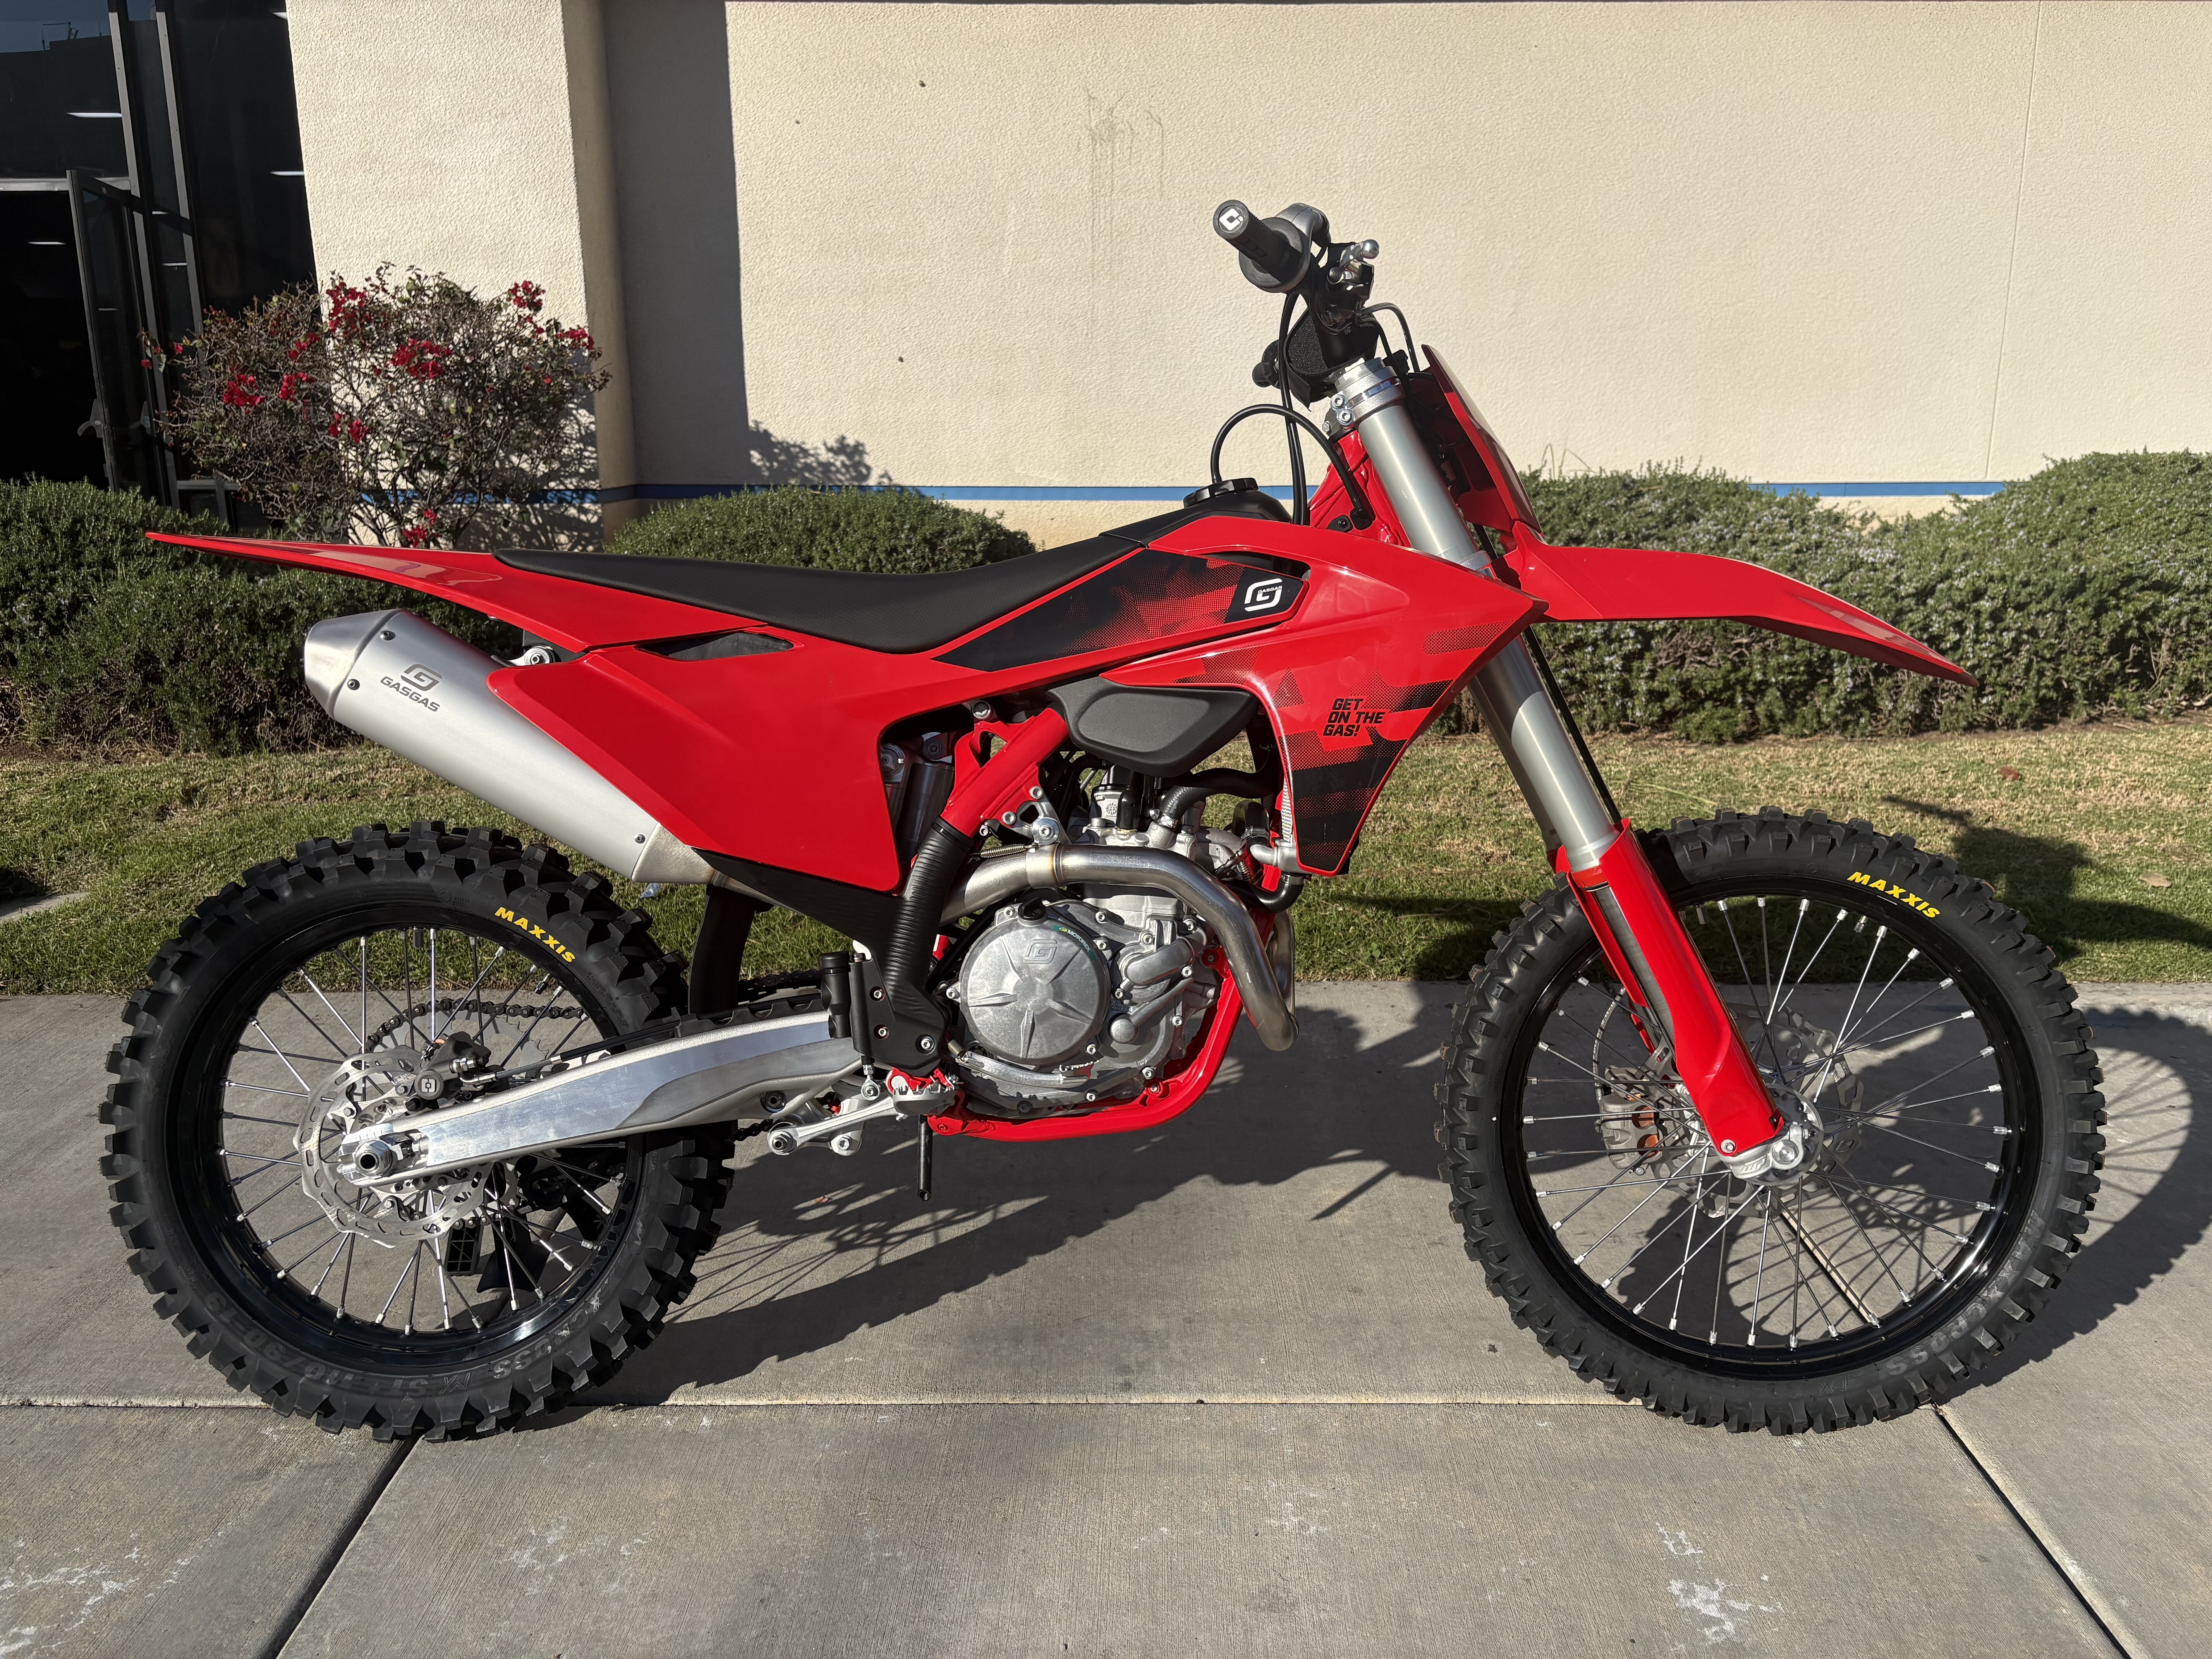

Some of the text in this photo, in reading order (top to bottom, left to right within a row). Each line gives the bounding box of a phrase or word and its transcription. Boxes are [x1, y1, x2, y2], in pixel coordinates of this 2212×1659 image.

[1257, 586, 1283, 594] GASGAS
[380, 676, 440, 712] GASGAS
[1332, 698, 1364, 710] GET
[1328, 711, 1386, 724] ON THE
[1323, 725, 1361, 737] GAS!
[1847, 871, 1940, 918] MAXXIS
[495, 907, 575, 962] MAXXIS
[1067, 929, 1091, 952] MOTOREX
[439, 1373, 471, 1395] MX
